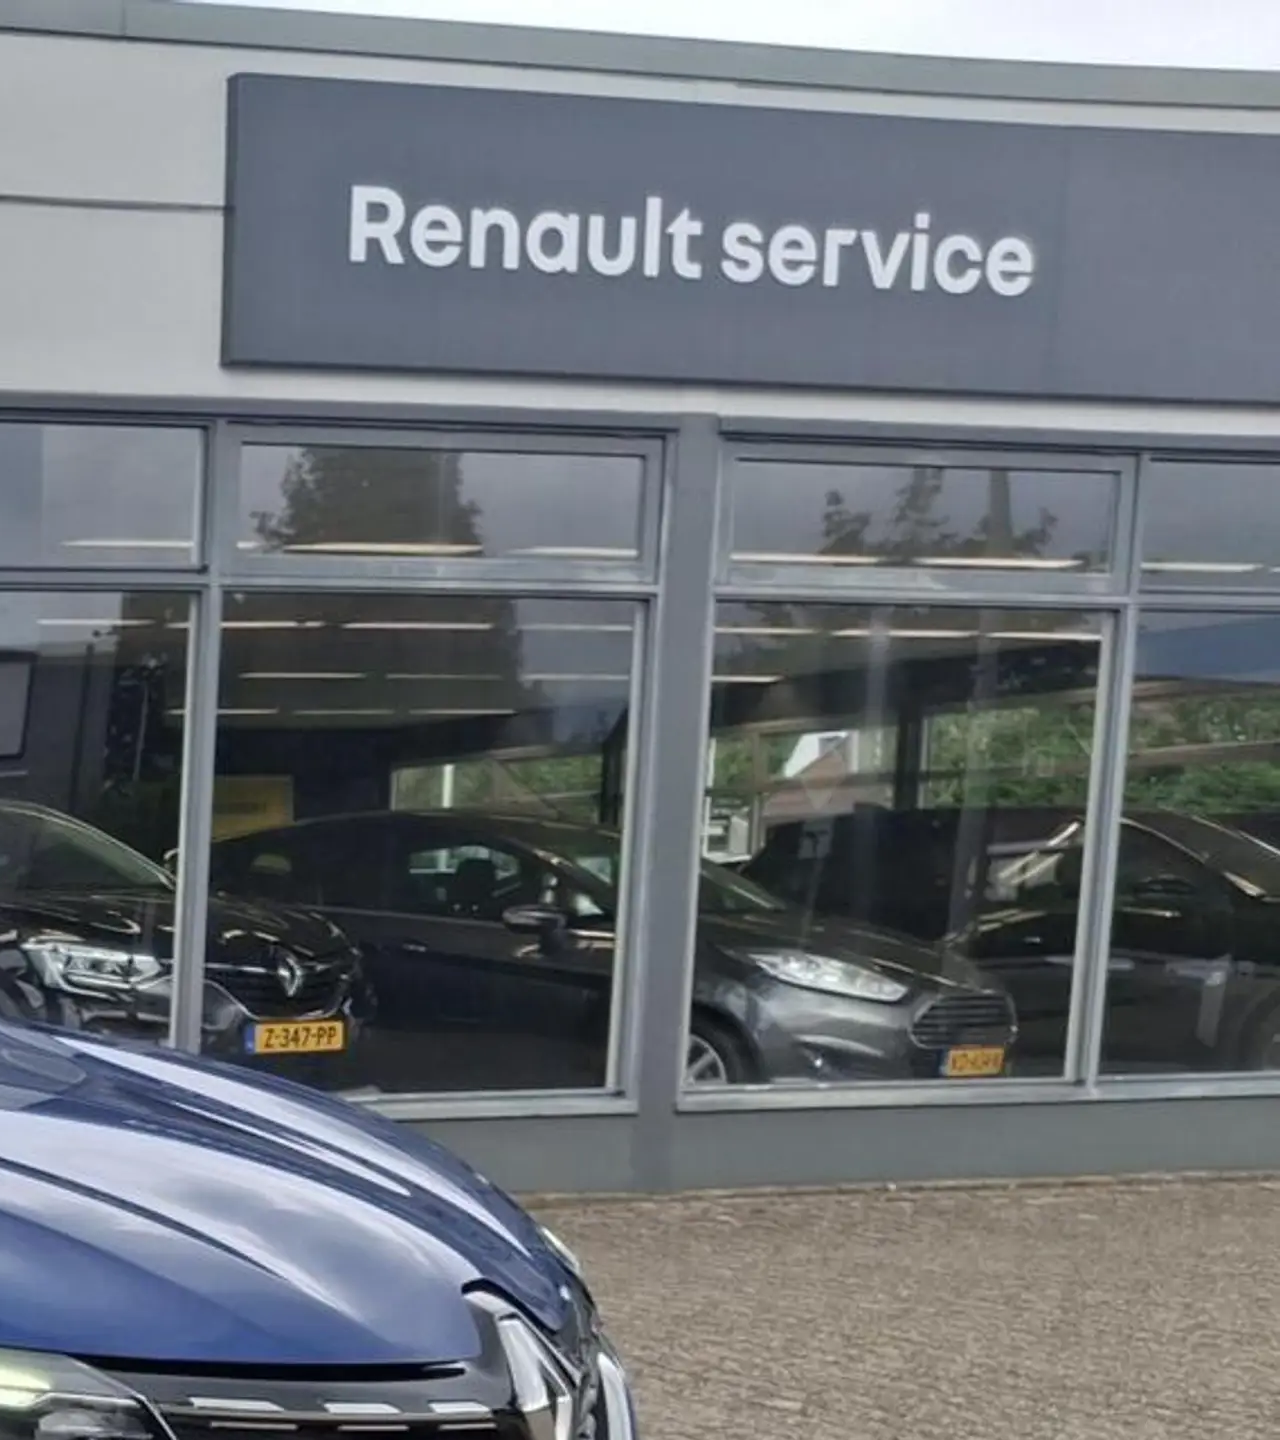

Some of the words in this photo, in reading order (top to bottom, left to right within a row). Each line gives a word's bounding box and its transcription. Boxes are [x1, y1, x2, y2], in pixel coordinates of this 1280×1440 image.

[349, 185, 702, 281] Renault
[721, 212, 1035, 297] service
[263, 1026, 337, 1049] Z-347-PP
